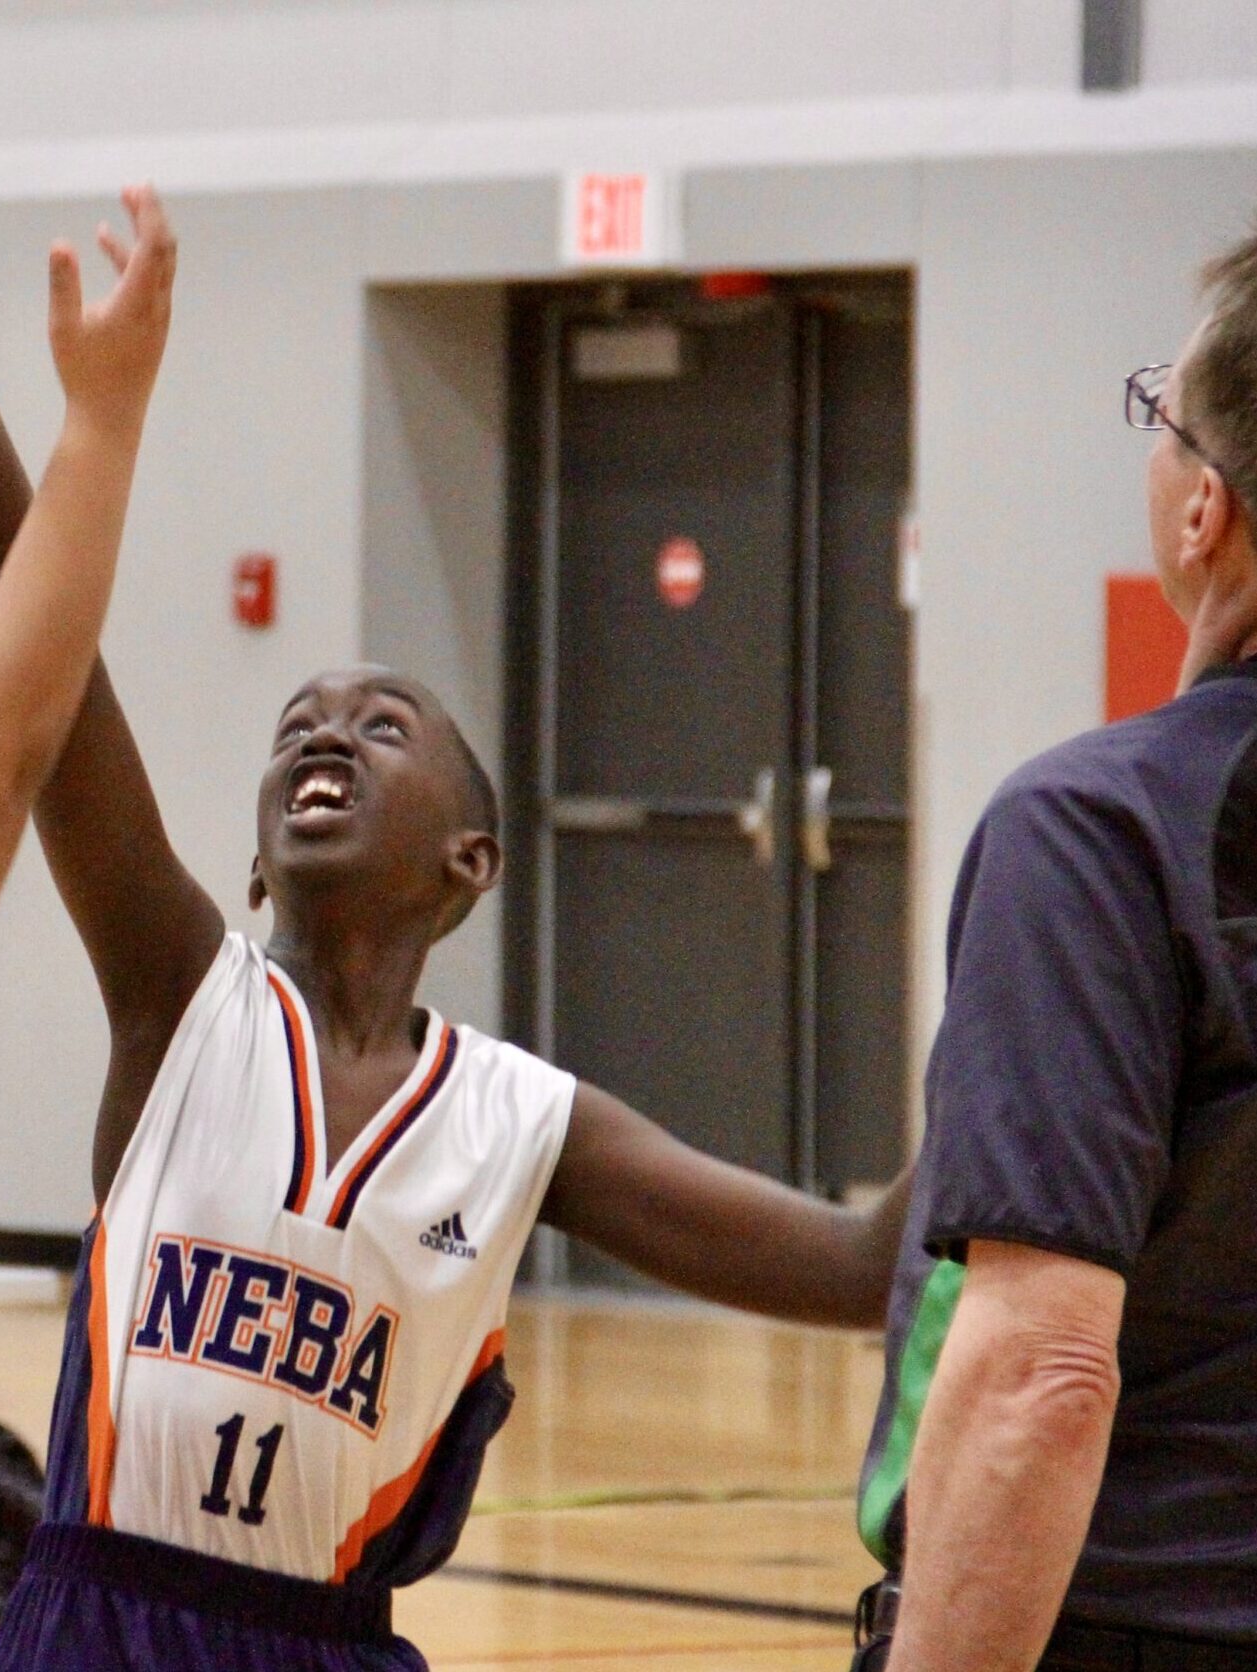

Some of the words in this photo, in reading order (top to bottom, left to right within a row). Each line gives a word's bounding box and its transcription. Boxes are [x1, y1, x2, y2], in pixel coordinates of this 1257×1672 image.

[579, 174, 645, 254] EXIT
[419, 1232, 477, 1260] adidas
[128, 1234, 400, 1440] NEBA
[200, 1413, 284, 1526] 11
